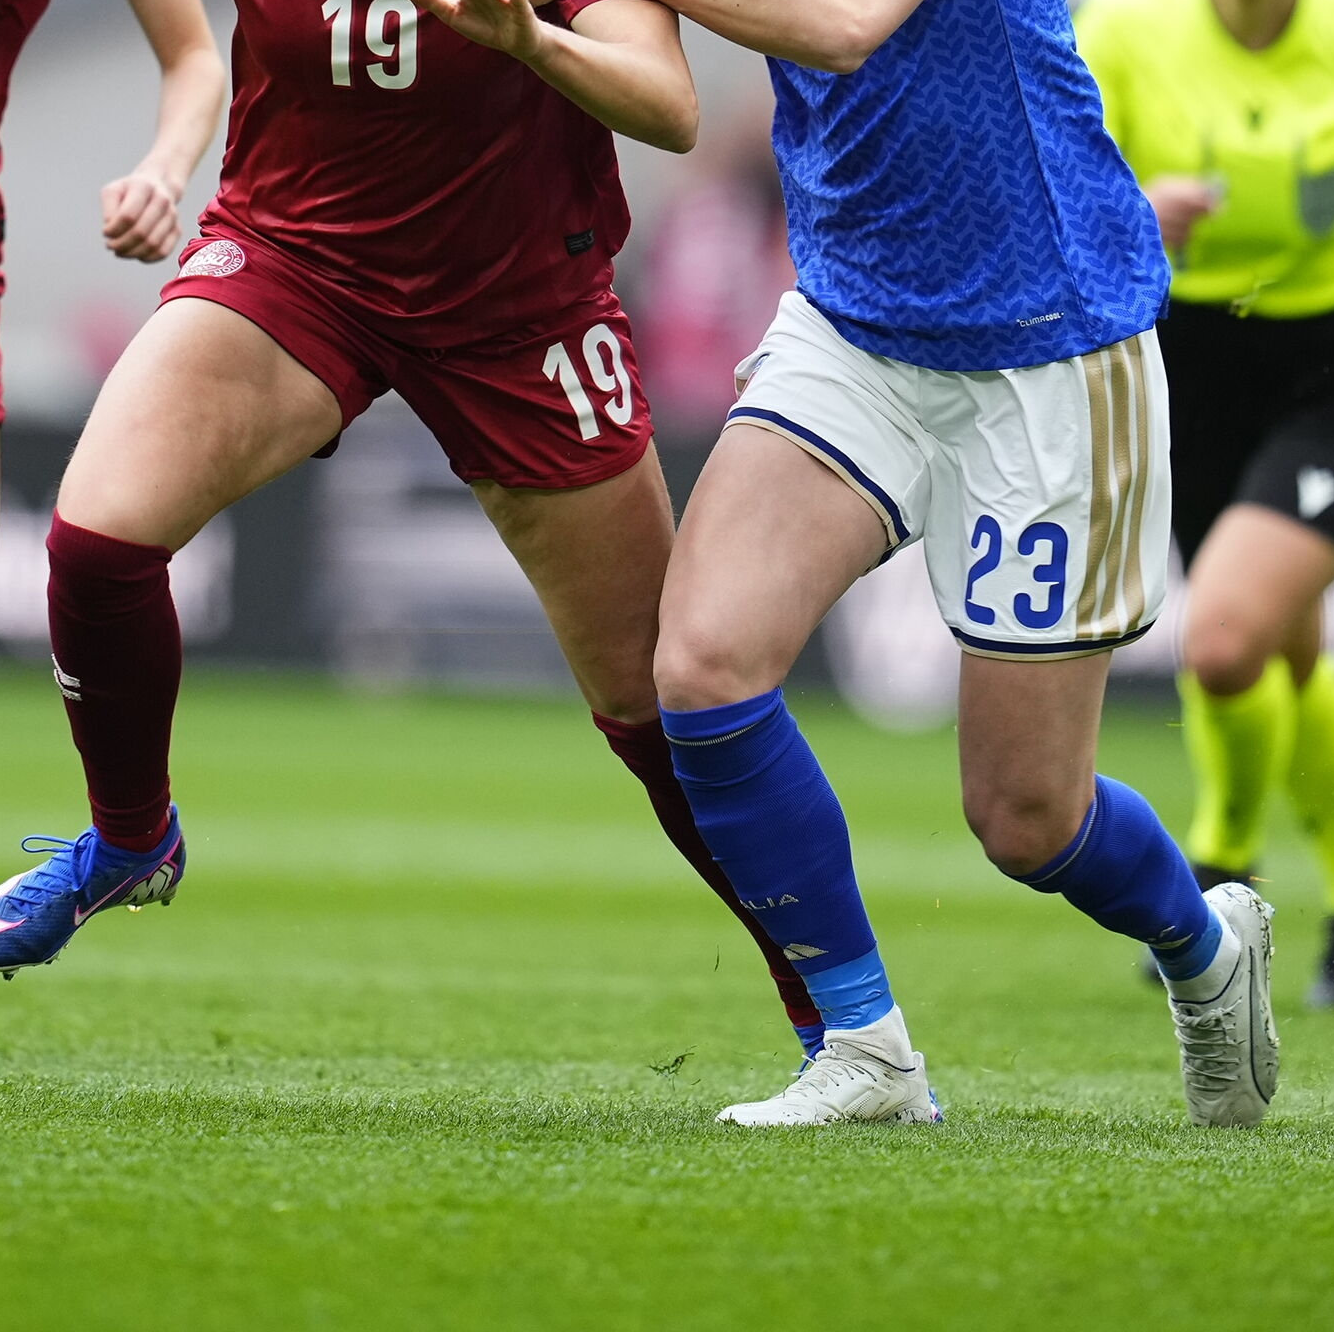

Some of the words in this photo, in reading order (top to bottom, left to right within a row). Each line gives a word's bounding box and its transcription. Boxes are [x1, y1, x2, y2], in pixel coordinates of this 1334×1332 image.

[1017, 311, 1063, 328] CLIMACOOL
[542, 323, 633, 442] 19
[964, 514, 1069, 629] 23
